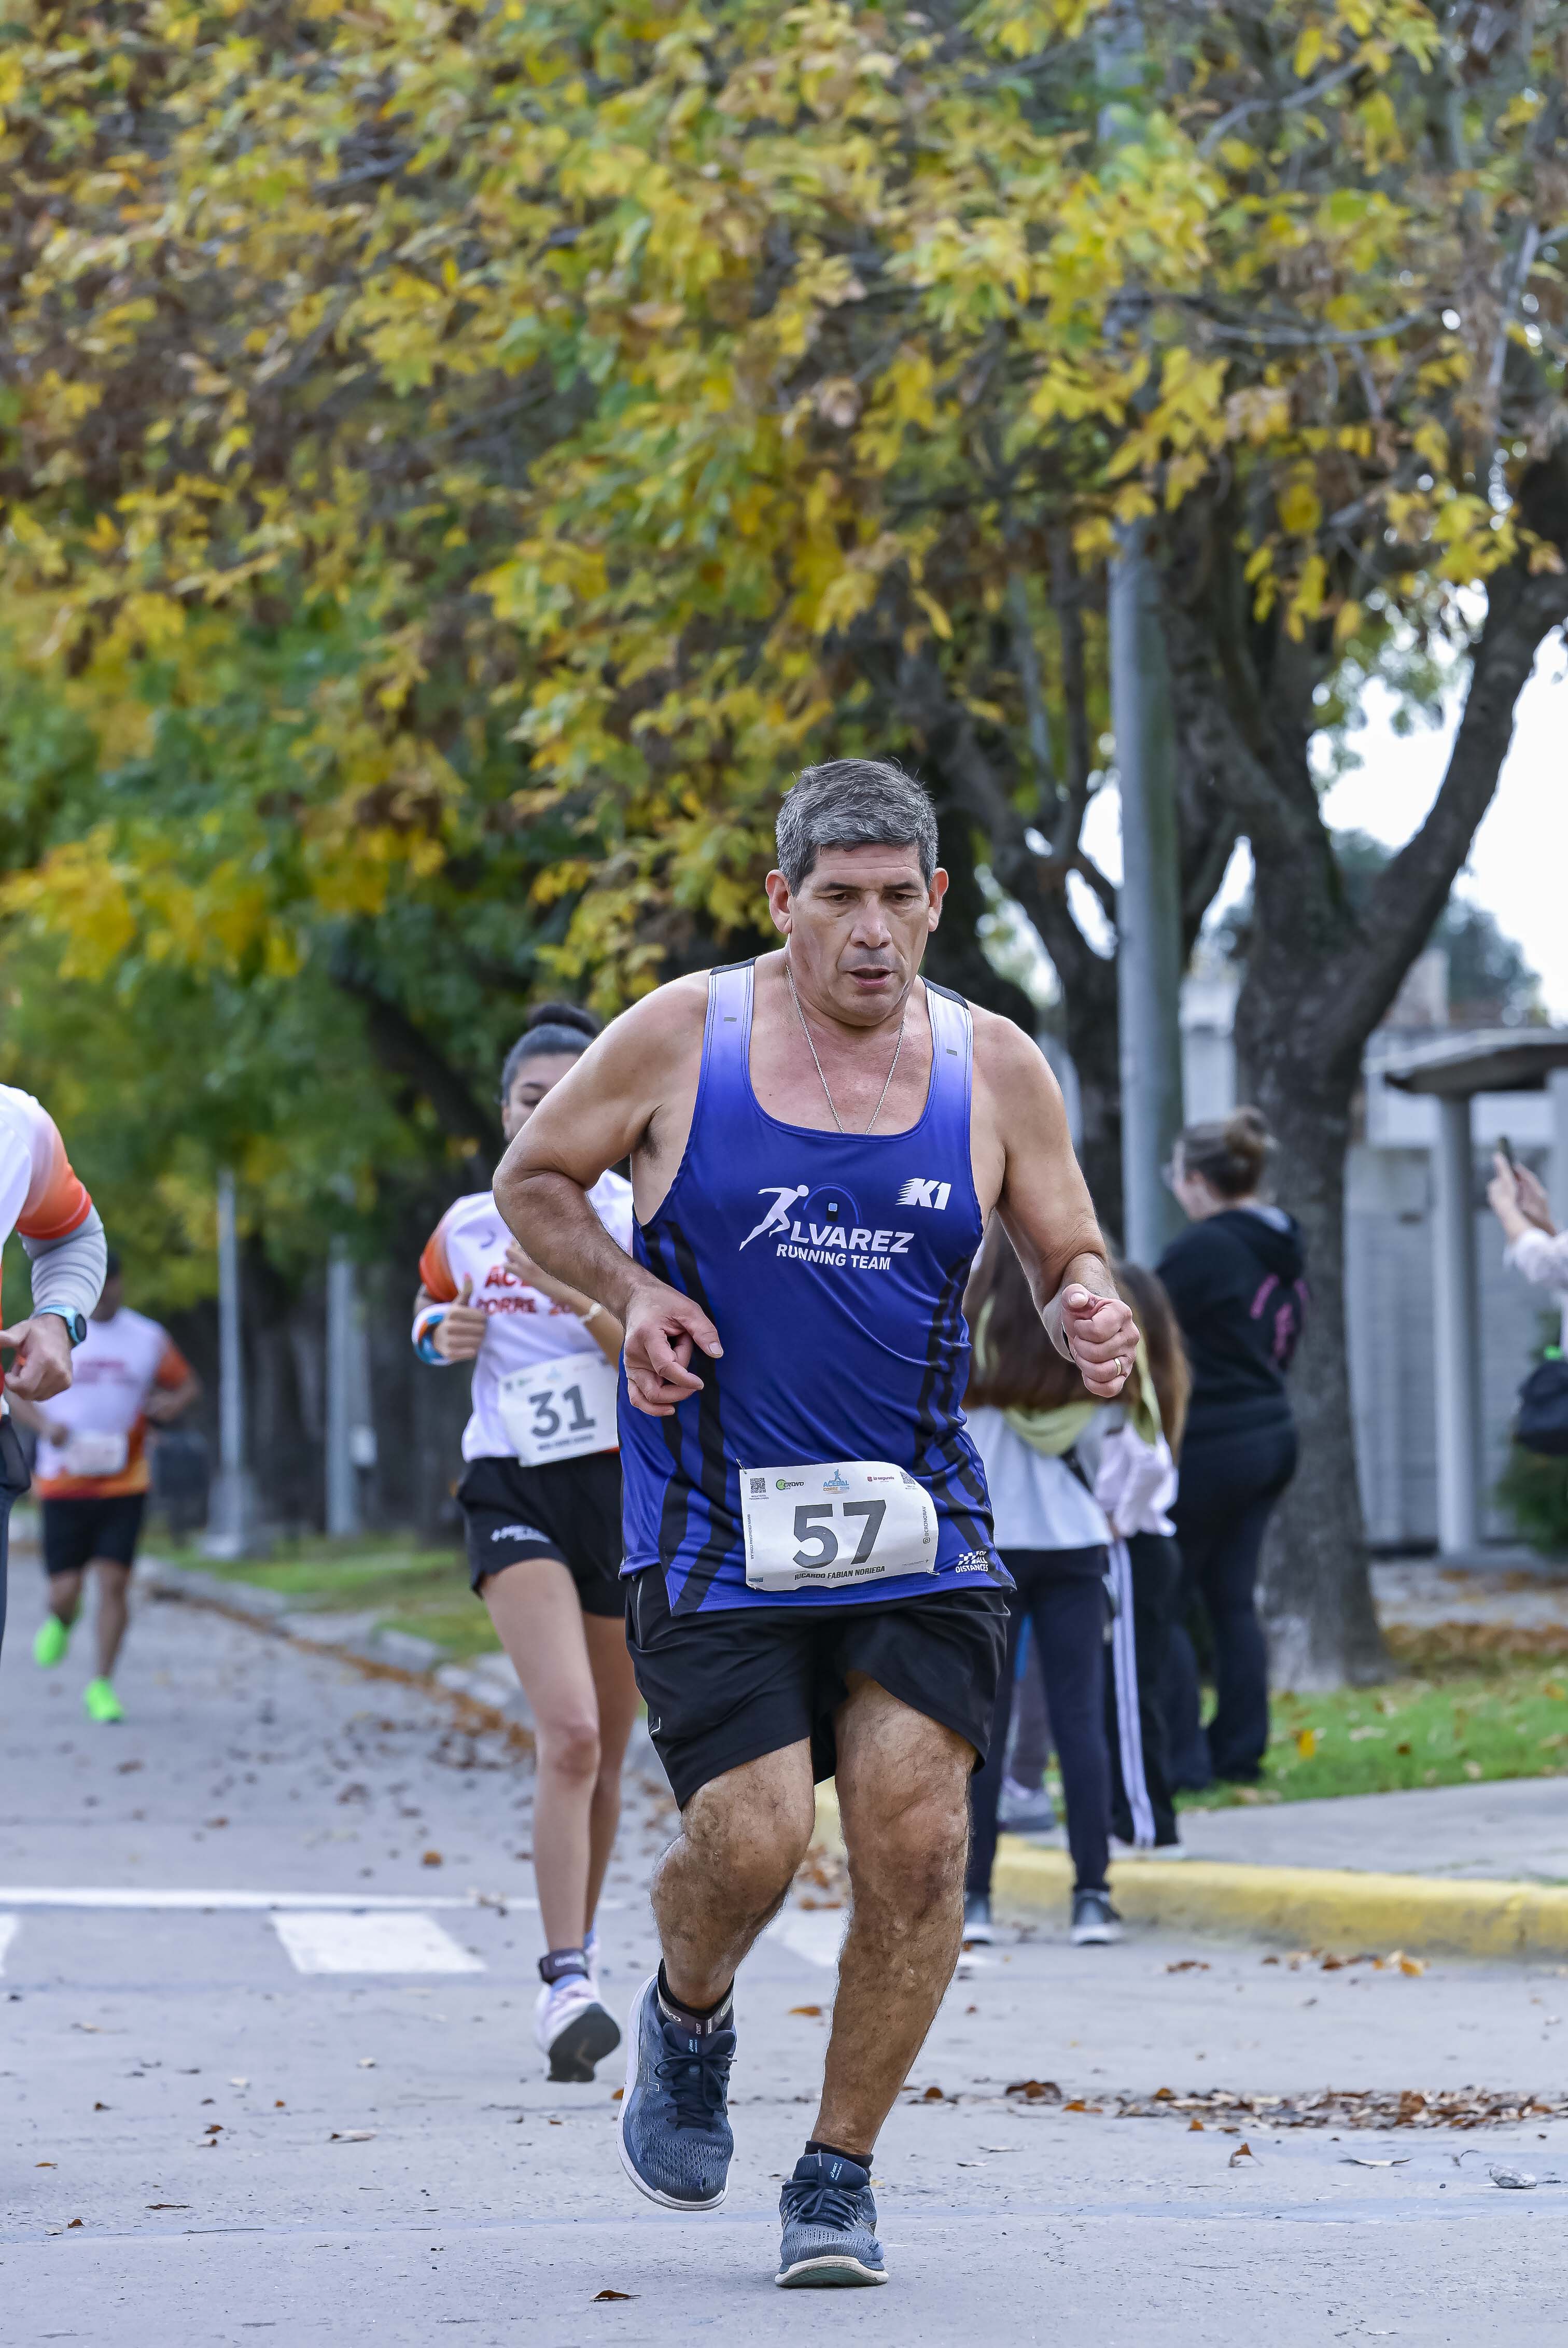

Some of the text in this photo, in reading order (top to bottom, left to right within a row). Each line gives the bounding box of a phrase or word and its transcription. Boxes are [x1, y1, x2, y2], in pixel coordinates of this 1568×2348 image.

[894, 1178, 952, 1210] K1
[776, 1243, 891, 1270] RUNNING TEAM
[529, 1385, 596, 1437] 31
[792, 1500, 887, 1569] 57
[794, 1566, 885, 1581] RICARDO FABIAN NORIEGA
[955, 1564, 988, 1573] DISTANCES
